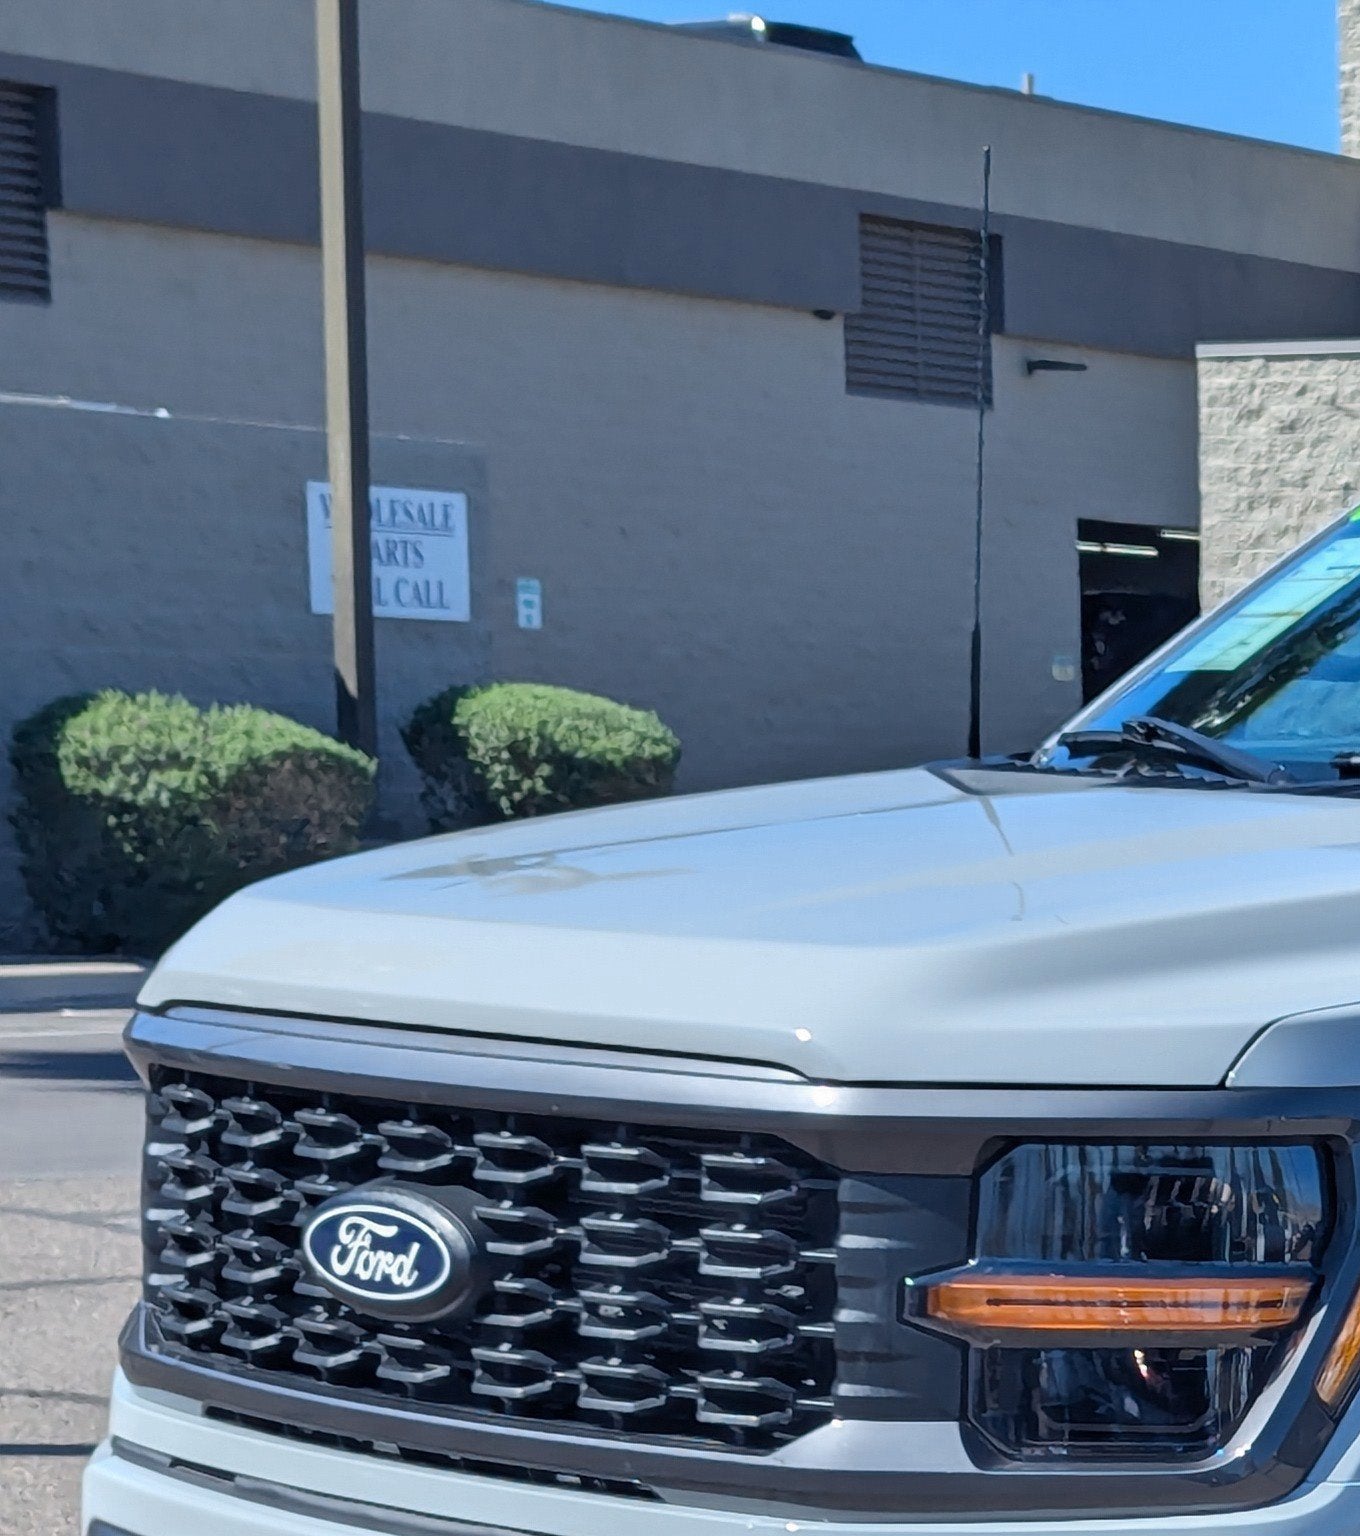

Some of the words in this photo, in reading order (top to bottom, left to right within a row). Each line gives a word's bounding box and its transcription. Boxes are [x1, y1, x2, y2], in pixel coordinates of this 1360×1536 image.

[371, 539, 425, 570] ARTS
[394, 576, 450, 610] CALL
[329, 1215, 421, 1288] Ford
